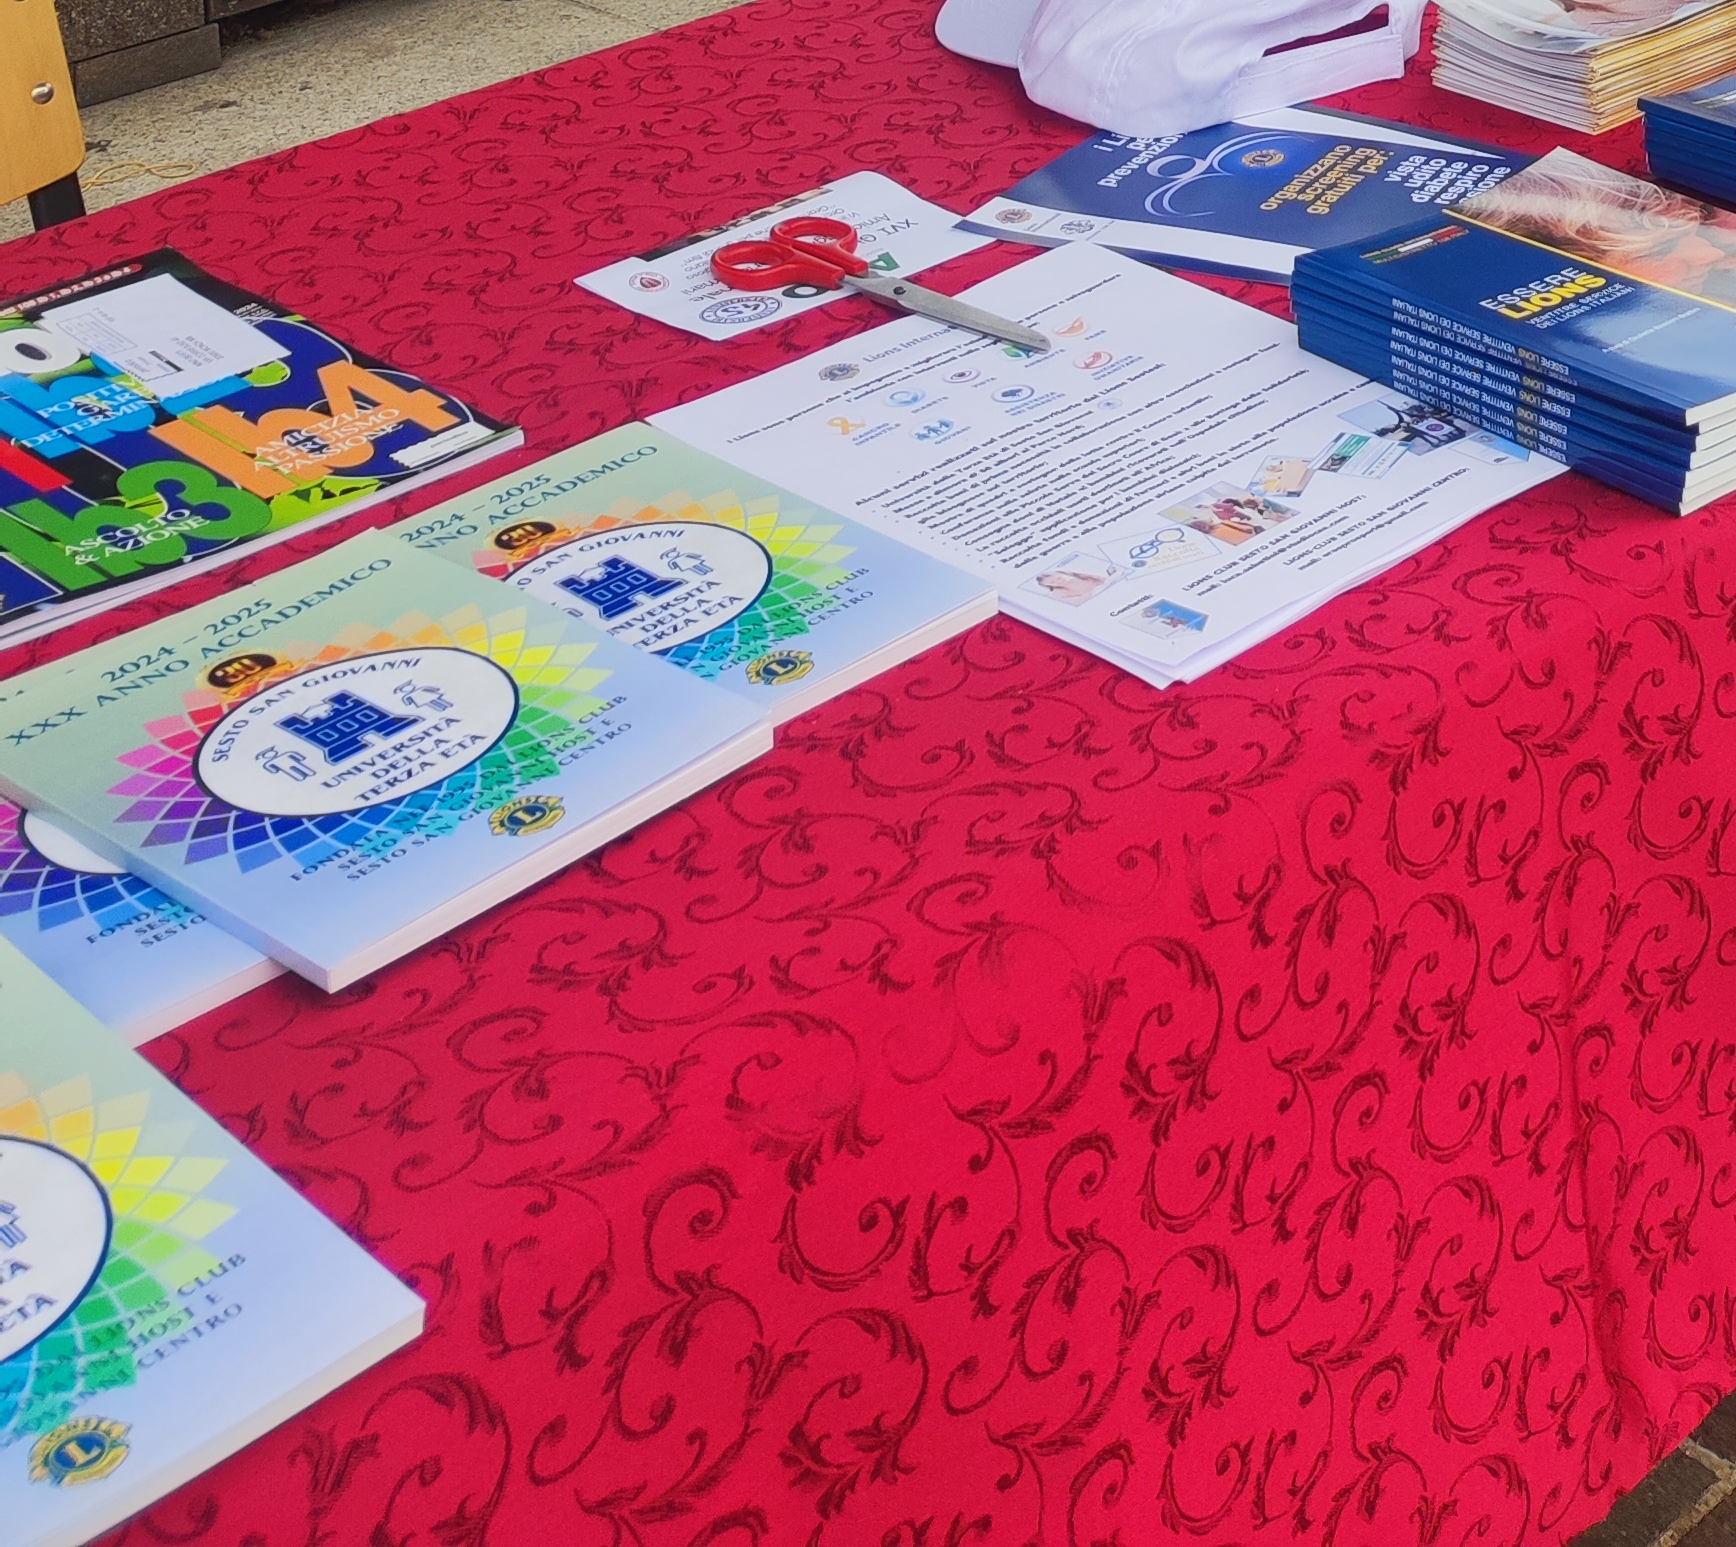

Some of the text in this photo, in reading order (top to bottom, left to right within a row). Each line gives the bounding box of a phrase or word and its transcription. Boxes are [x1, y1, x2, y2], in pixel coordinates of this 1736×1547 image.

[1097, 132, 1188, 189] prevenzio
[1259, 144, 1352, 212] organizzano
[1297, 146, 1378, 203] screening
[1306, 149, 1396, 216] gratuiti per:
[1384, 153, 1427, 183] vista
[1403, 157, 1447, 190] udito
[1410, 160, 1469, 205] diabete
[1433, 163, 1490, 206] respiro
[1479, 266, 1587, 312] ESSERE
[1499, 274, 1608, 319] LIONS
[1452, 322, 1481, 341] SERVICE
[1541, 357, 1570, 376] ESSERE
[253, 403, 376, 457] AMICIZIA
[253, 408, 401, 474] ALTRUISMO
[281, 420, 405, 476] PASSIONE
[401, 474, 551, 544] 2024 2025
[486, 446, 658, 526] ACCADEMICO
[64, 507, 193, 557] ASCOLTO
[100, 515, 214, 559] AZIONE
[533, 528, 686, 580] SAN GIOVANNI
[825, 567, 870, 592] CLUB
[101, 598, 273, 683] 2024 2025
[640, 601, 711, 638] DELLA
[6, 557, 393, 747] XXX ANNO ACCADEMICO
[211, 657, 424, 764] SESTO SAN GIOVANNI
[577, 694, 629, 724] CLUB
[321, 715, 463, 789] UNIVERSITÀ
[369, 736, 451, 781] DELLA
[353, 759, 439, 805] TERZA
[176, 1253, 248, 1296] CLUB
[136, 1303, 244, 1371] CENTRO
